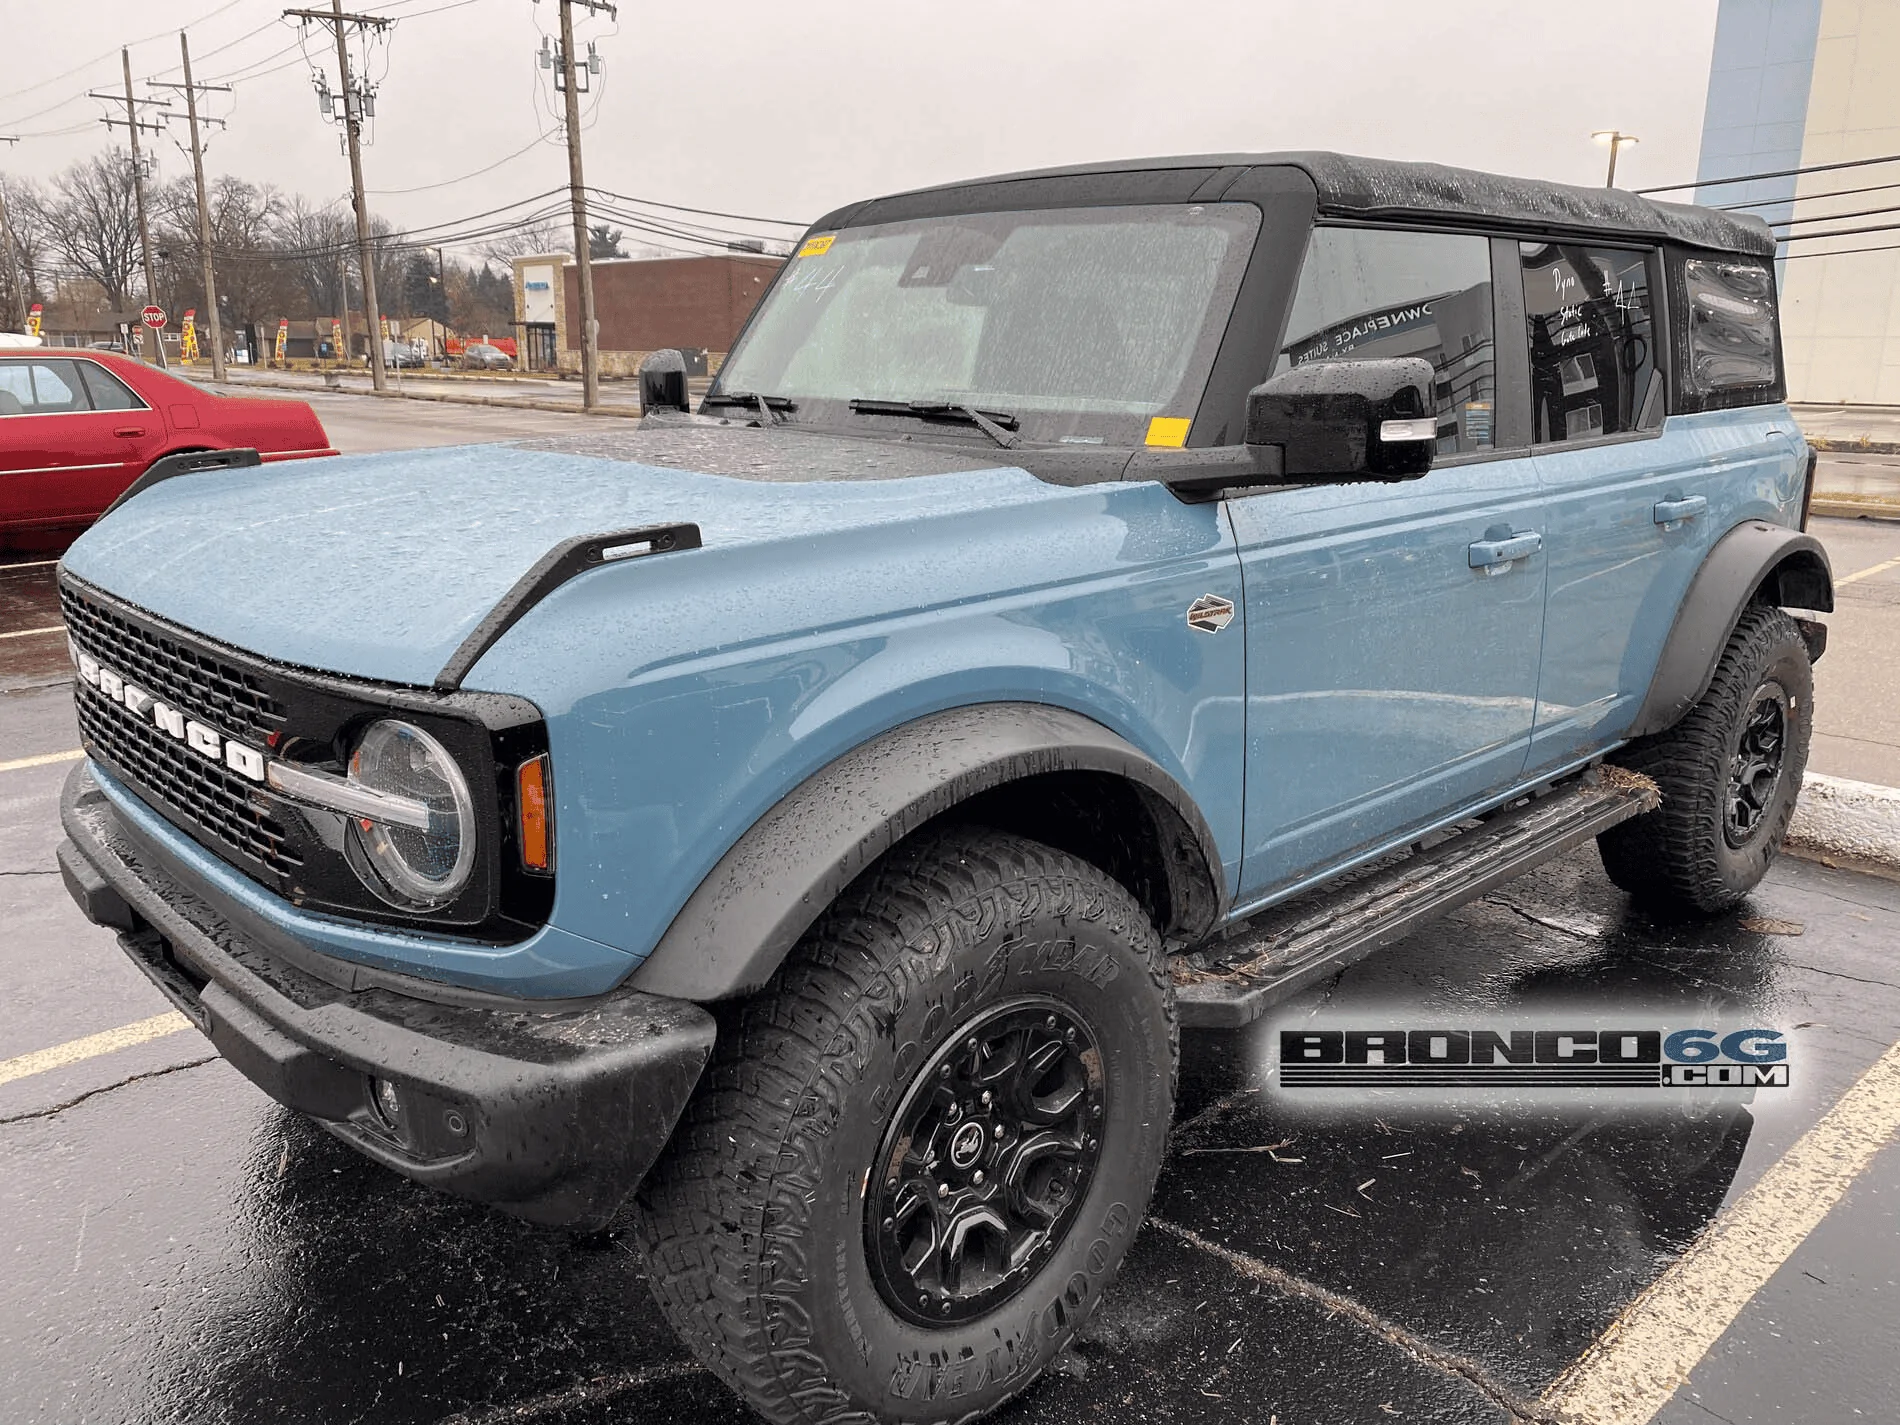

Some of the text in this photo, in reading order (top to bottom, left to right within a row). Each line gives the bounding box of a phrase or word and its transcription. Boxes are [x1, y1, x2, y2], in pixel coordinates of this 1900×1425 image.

[1553, 267, 1575, 301] Dyno
[143, 312, 164, 322] STOP
[79, 653, 265, 782] BRONCO
